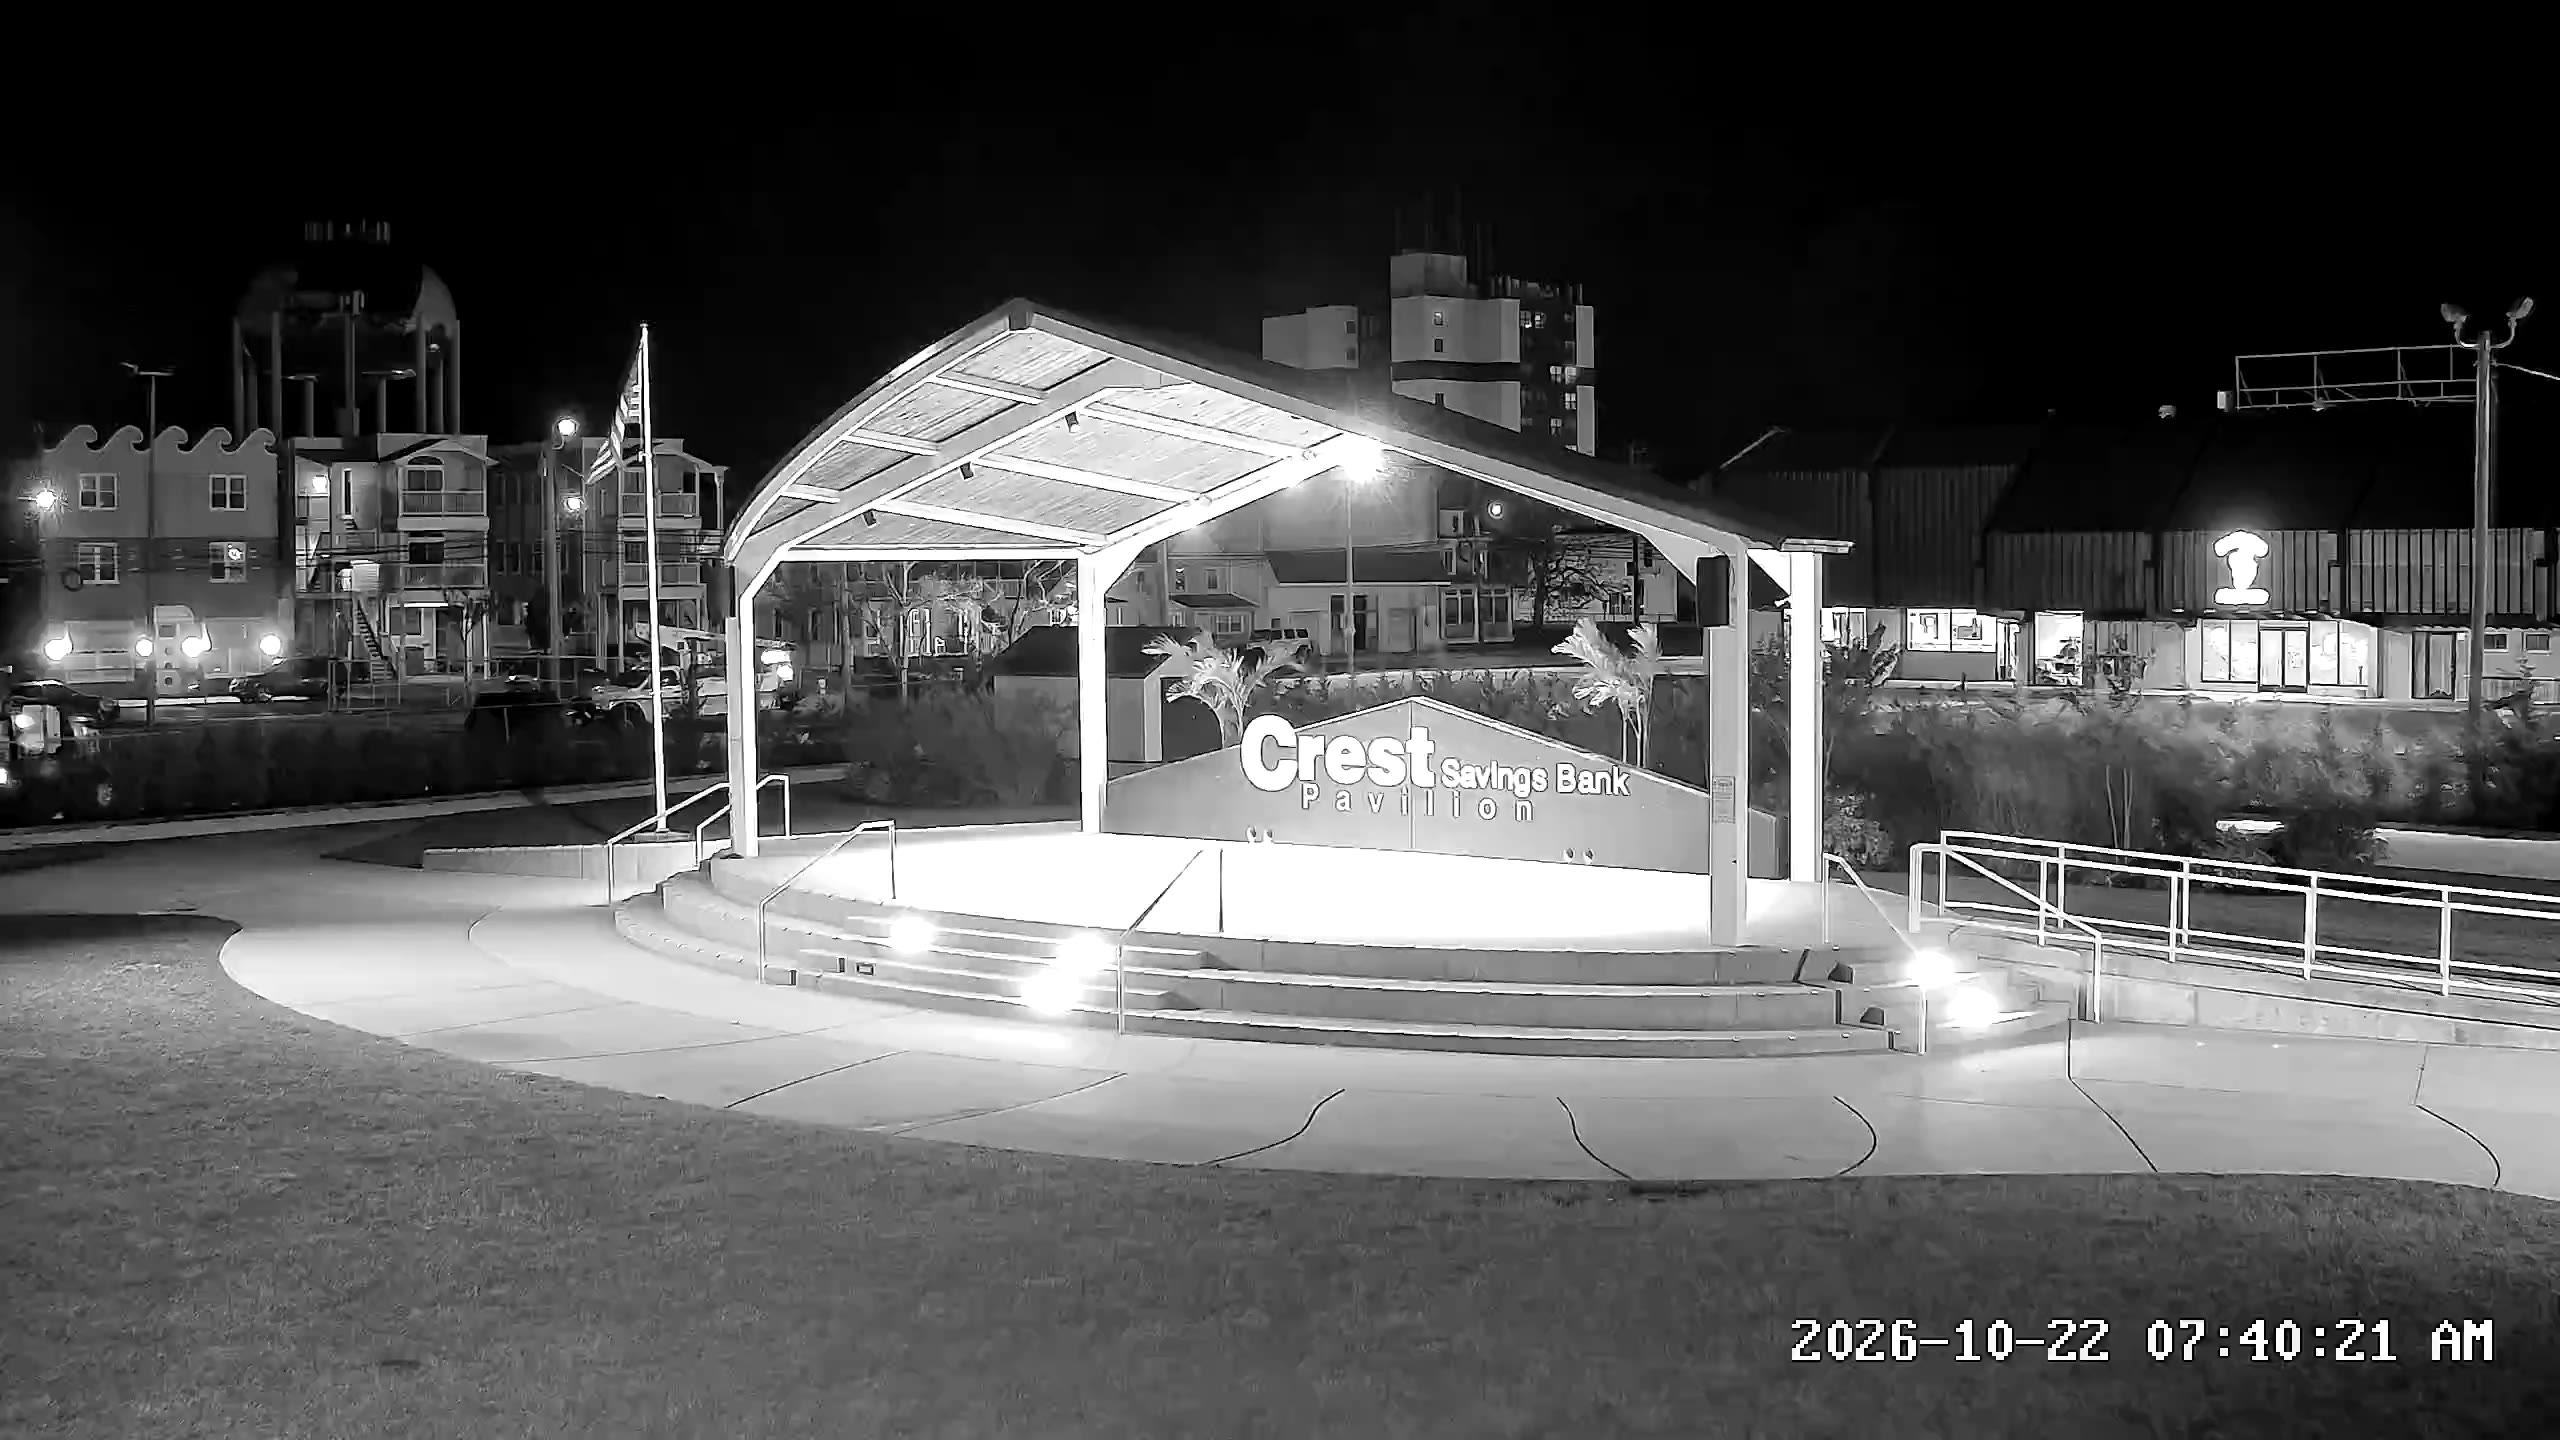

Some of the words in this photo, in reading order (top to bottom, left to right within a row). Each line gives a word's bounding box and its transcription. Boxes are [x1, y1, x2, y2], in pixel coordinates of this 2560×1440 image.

[1240, 714, 1436, 792] Crest
[1439, 757, 1549, 798] Savings
[1555, 763, 1631, 797] Bank
[1301, 783, 1535, 822] Pavilion
